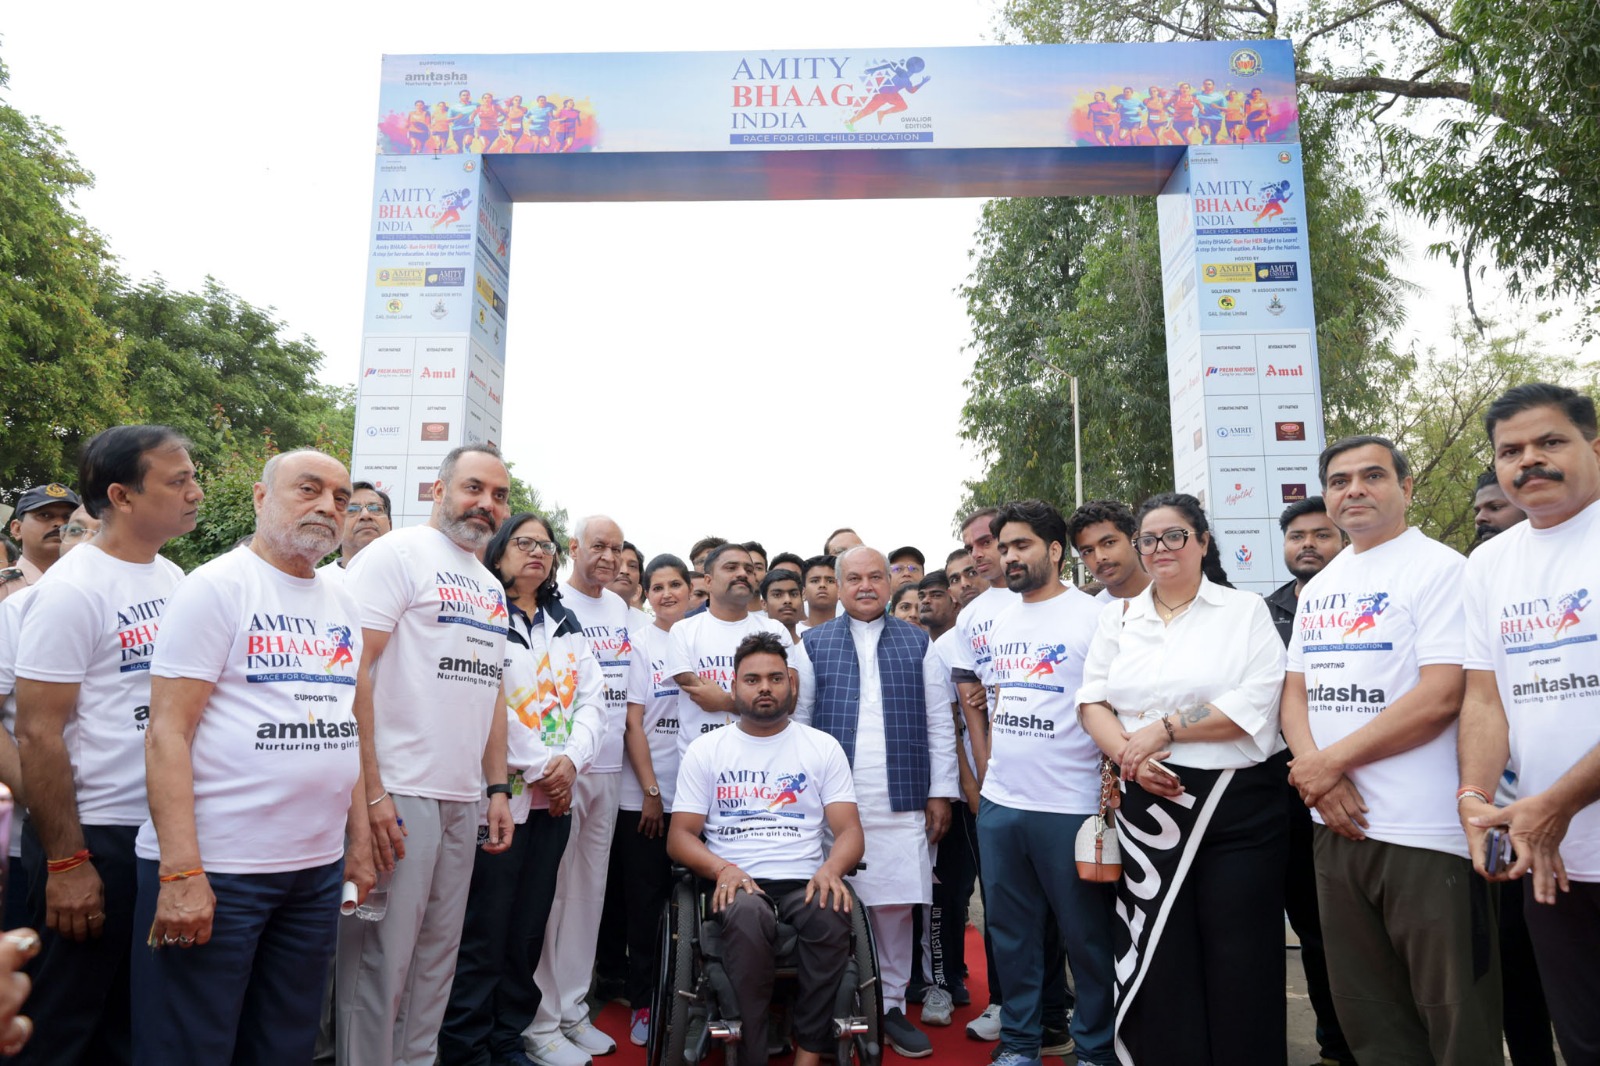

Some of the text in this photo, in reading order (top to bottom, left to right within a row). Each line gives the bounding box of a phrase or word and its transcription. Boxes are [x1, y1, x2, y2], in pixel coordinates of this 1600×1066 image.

[731, 57, 847, 80] AMITY
[405, 71, 467, 81] amitasha
[730, 84, 854, 107] BHAAG
[731, 112, 807, 129] INDIA
[797, 134, 820, 142] GIRL
[858, 133, 919, 141] EDUCATION
[379, 188, 435, 202] AMITY
[1194, 180, 1253, 196] AMITY
[379, 204, 435, 219] BHAAG
[1195, 198, 1256, 213] BHAAG
[378, 221, 413, 231] INDIA
[1196, 215, 1235, 226] INDIA
[420, 367, 456, 378] Amul
[1266, 364, 1303, 377] Amul
[435, 571, 481, 593] AMITY
[438, 588, 490, 610] BHAAG
[440, 601, 475, 616] INDIA
[1500, 597, 1551, 619] AMITY
[248, 613, 316, 636] AMITY
[1500, 613, 1556, 634] BHAAG
[246, 635, 326, 656] BHAAG
[466, 636, 494, 648] SUPPORTING
[1501, 632, 1534, 645] INDIA
[246, 653, 302, 669] INDIA
[437, 672, 486, 685] Nurturing the
[1512, 673, 1599, 696] amitasha
[1028, 683, 1058, 691] EDUCATION
[294, 693, 338, 702] SUPPORTING
[1560, 692, 1576, 700] girl
[1034, 731, 1055, 739] child
[255, 742, 320, 751] Nurturing
[323, 741, 338, 749] the
[717, 770, 769, 784] AMITY
[717, 786, 771, 799] BHAAG
